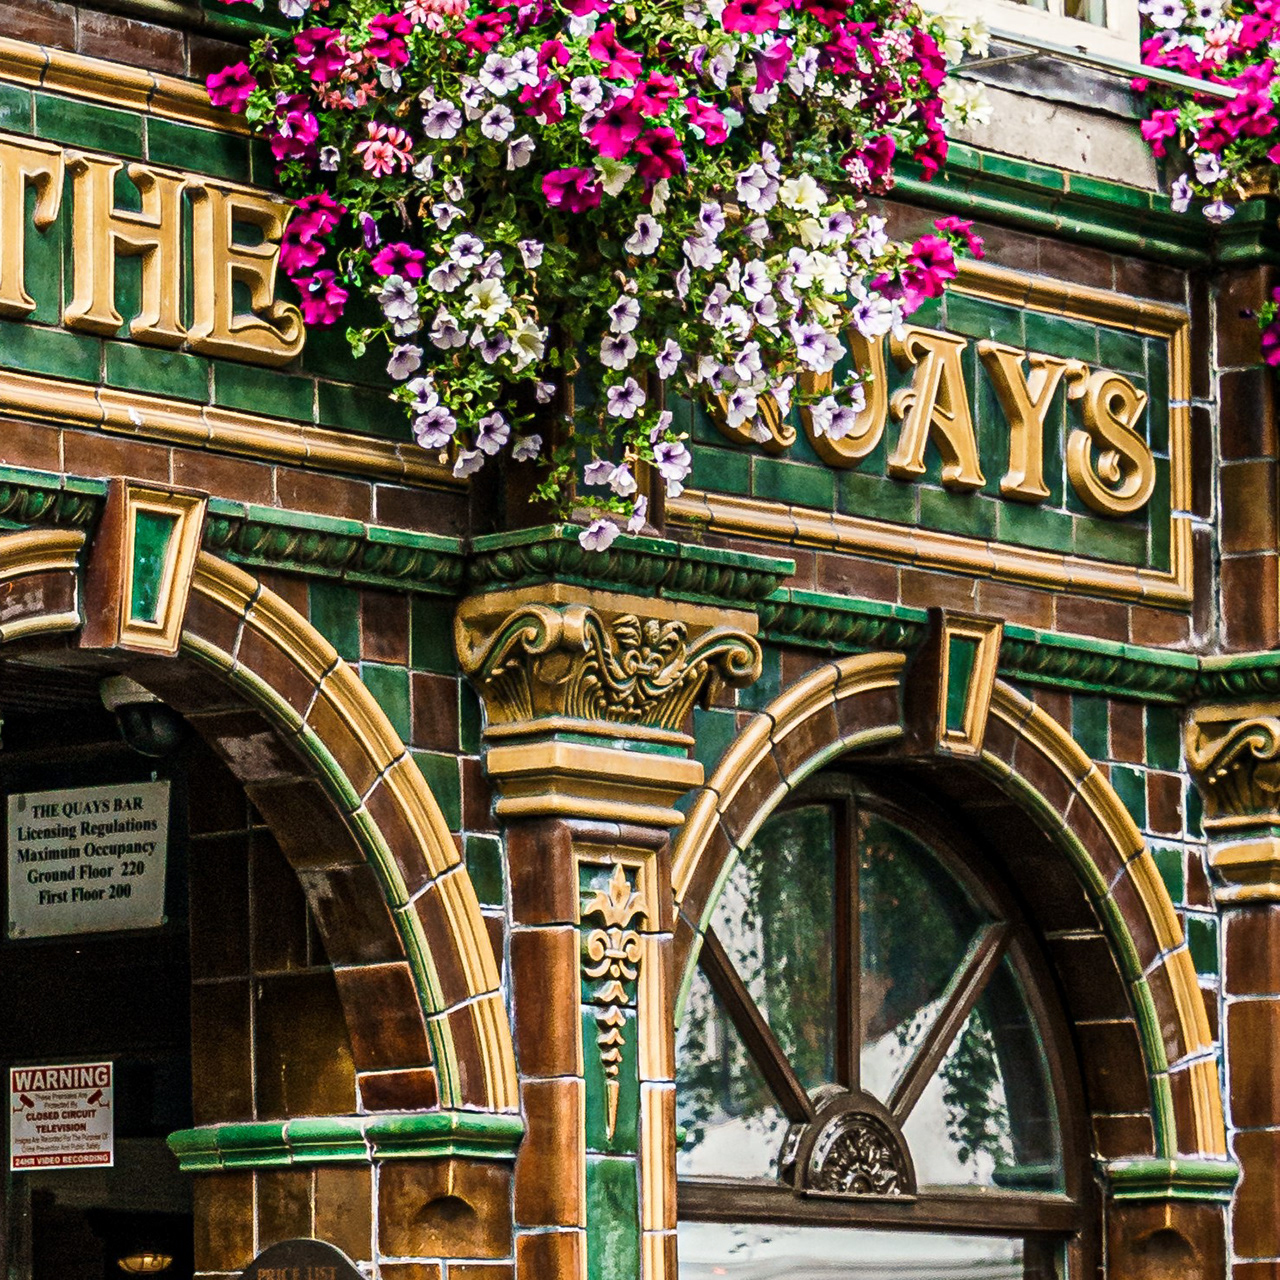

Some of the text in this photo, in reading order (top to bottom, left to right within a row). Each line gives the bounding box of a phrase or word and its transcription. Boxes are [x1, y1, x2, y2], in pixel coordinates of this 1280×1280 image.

[32, 797, 144, 819] THE QUAYS BAR
[17, 818, 158, 842] Licensing Regulations
[17, 841, 157, 864] Maximum Occupancy
[27, 861, 145, 884] Ground Floor 220
[38, 883, 132, 905] First Floor 200
[15, 1066, 108, 1091] WARNING
[26, 1109, 97, 1122] CLOSED CIRCUIT
[36, 1123, 87, 1133] TELEVISION
[37, 1156, 61, 1165] VIDEO
[62, 1154, 109, 1164] RECORDING
